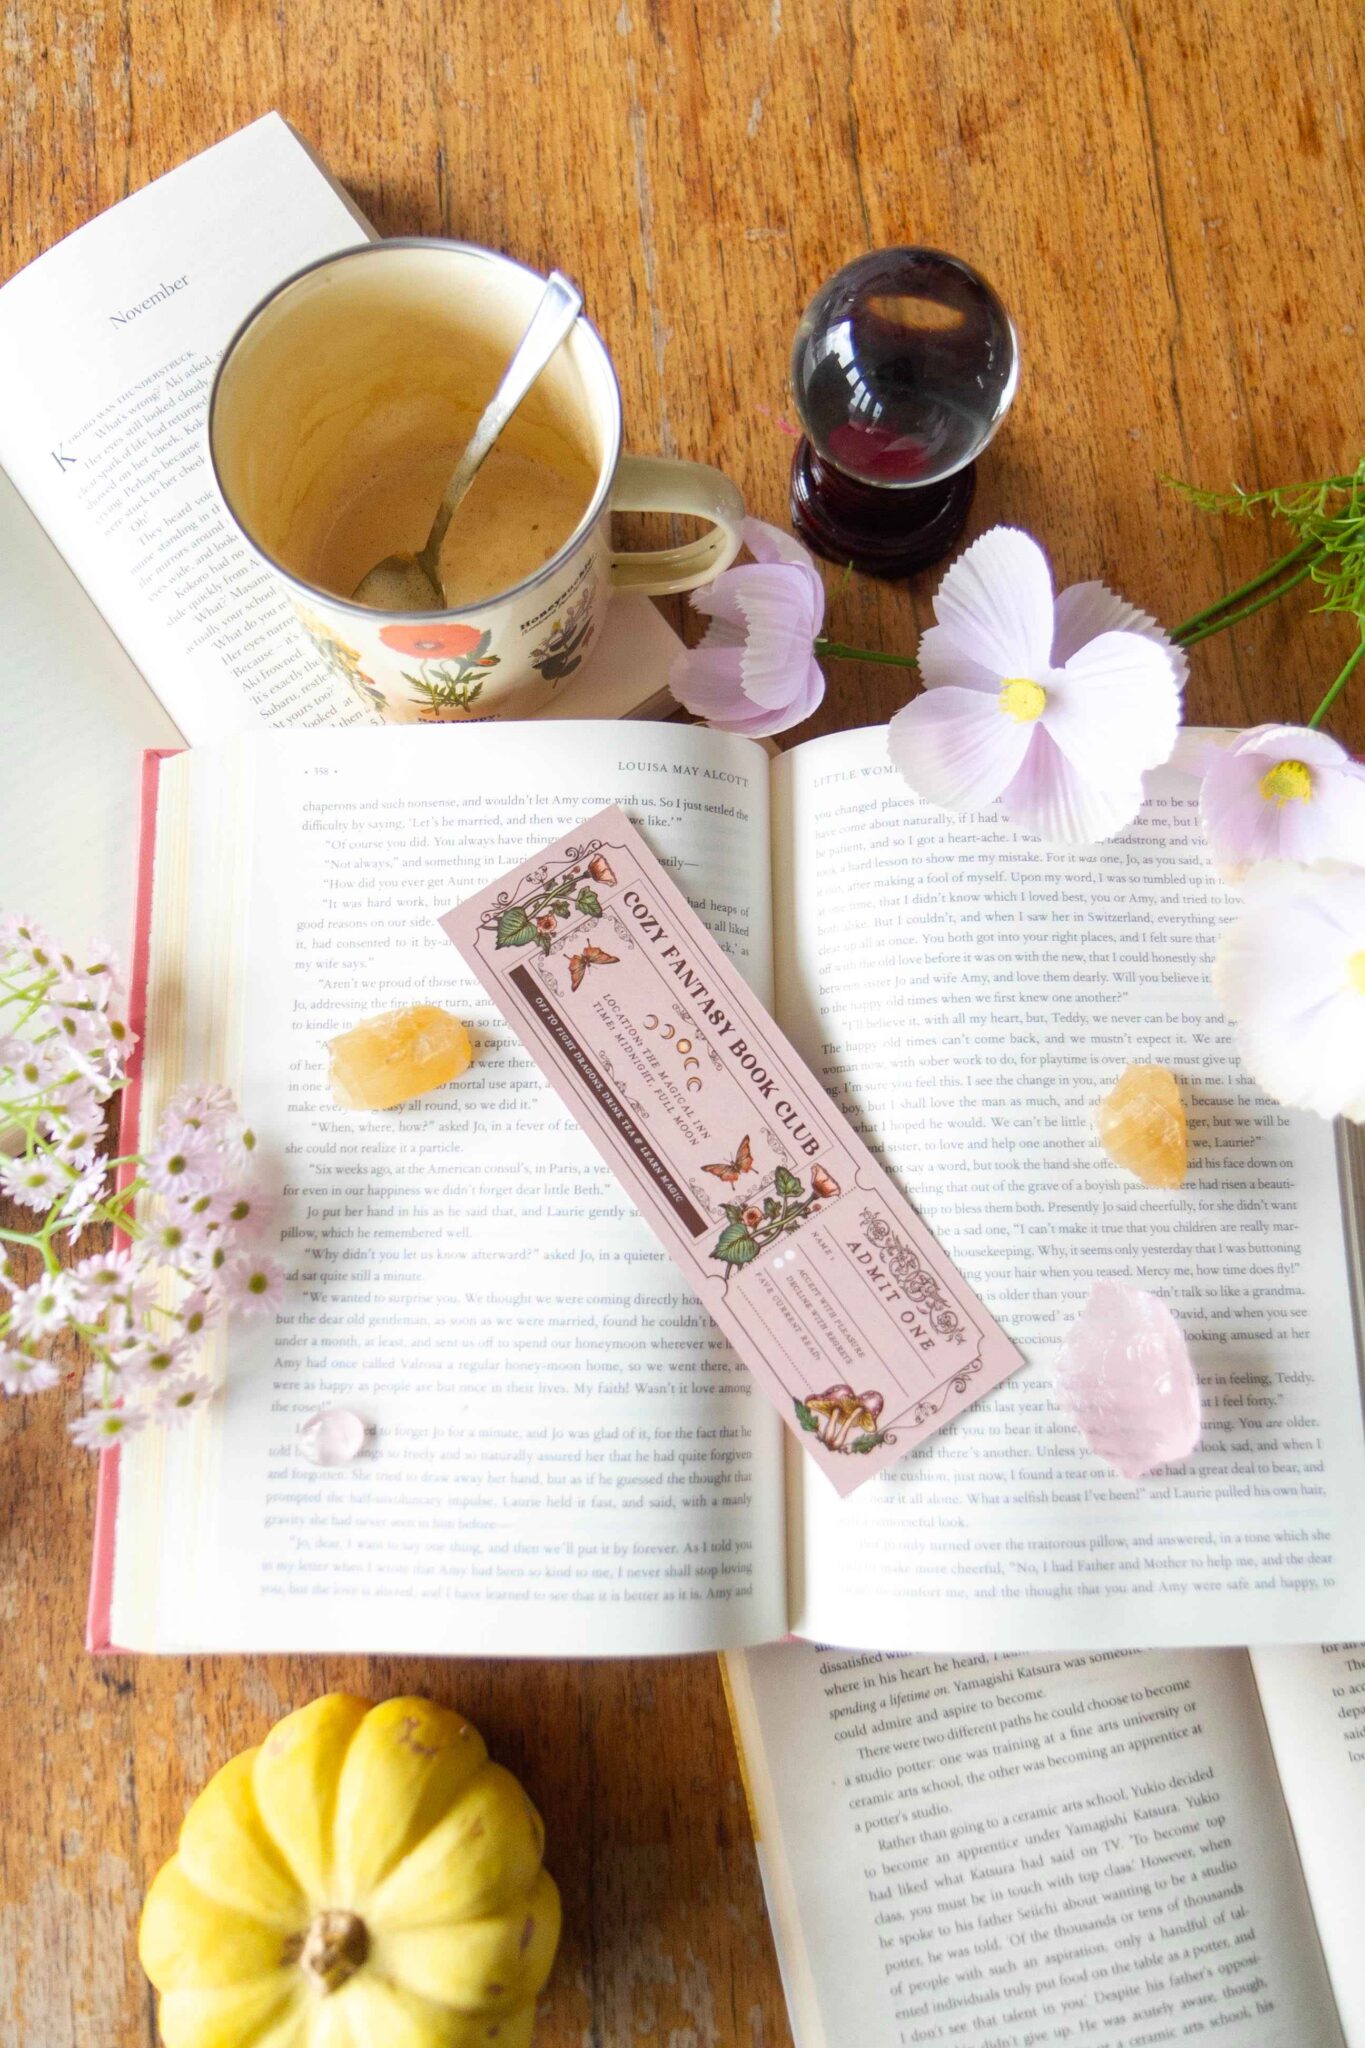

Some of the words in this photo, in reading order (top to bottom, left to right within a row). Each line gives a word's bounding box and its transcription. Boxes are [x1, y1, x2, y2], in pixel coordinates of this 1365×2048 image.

[108, 274, 188, 330] November
[166, 375, 183, 391] Aki
[138, 526, 162, 546] They
[162, 502, 193, 527] heard
[174, 572, 210, 599] Kokoro
[209, 556, 230, 574] had
[231, 549, 246, 562] no
[242, 674, 260, 692] Aki
[270, 670, 304, 696] exactly
[618, 761, 667, 772] LOUISA
[672, 764, 699, 775] MAY
[703, 769, 748, 787] ALCOTT
[814, 770, 856, 788] LITTLE
[301, 819, 348, 832] difficulty
[351, 818, 364, 831] by
[441, 815, 454, 826] be
[506, 813, 525, 824] and
[529, 813, 552, 824] then
[302, 800, 356, 814] chaperons
[359, 799, 378, 809] and
[380, 798, 404, 808] such
[461, 795, 481, 806] and
[535, 793, 548, 804] let
[552, 795, 579, 807] Amy
[582, 796, 610, 806] come
[615, 794, 640, 806] with
[659, 797, 673, 807] So
[676, 798, 680, 808] I
[682, 798, 701, 811] just
[703, 803, 734, 817] settled
[736, 808, 748, 821] the
[629, 817, 645, 827] we
[874, 917, 893, 927] But
[897, 914, 901, 926] I
[960, 911, 981, 922] and
[984, 910, 1015, 921] when
[1019, 911, 1023, 921] I
[1051, 911, 1070, 921] her
[1073, 912, 1084, 921] in
[1157, 912, 1216, 927] everything
[623, 891, 668, 942] COZY
[660, 944, 735, 1036] FANTASY
[728, 1038, 779, 1099] BOOK
[775, 1100, 819, 1155] CLUB
[535, 996, 549, 1011] OFF
[547, 1013, 557, 1025] TO
[555, 1027, 576, 1050] FIGHT
[573, 1051, 603, 1091] DRAGONS,
[601, 1091, 623, 1118] DRINK
[621, 1119, 635, 1136] TEA
[640, 1146, 662, 1173] LEARN
[660, 1175, 682, 1201] MAGIC
[614, 1032, 655, 1086] MIDNIGHT,
[653, 1088, 674, 1113] FULL
[673, 1115, 699, 1145] MOON
[642, 1047, 660, 1068] THE
[657, 1070, 694, 1117] MAGICAL
[692, 1119, 710, 1138] INN
[282, 1183, 300, 1197] for
[301, 1187, 328, 1195] even
[331, 1185, 341, 1195] in
[344, 1187, 365, 1196] our
[366, 1183, 420, 1199] happiness
[423, 1187, 439, 1195] we
[479, 1184, 512, 1197] forget
[515, 1183, 540, 1194] dear
[544, 1183, 569, 1195] little
[936, 1222, 951, 1236] be
[963, 1223, 983, 1235] sad
[1058, 1222, 1087, 1233] make
[1090, 1222, 1099, 1233] it
[1100, 1224, 1123, 1233] true
[1125, 1221, 1147, 1232] that
[1149, 1224, 1171, 1236] you
[1172, 1220, 1217, 1232] children
[1239, 1219, 1269, 1234] really
[754, 1271, 774, 1294] FAVE
[772, 1294, 802, 1332] CURRENT
[785, 1275, 812, 1309] DECLINE
[810, 1308, 828, 1330] WITH
[824, 1330, 853, 1364] REGRETS
[798, 1269, 821, 1296] ACCEPT
[819, 1296, 838, 1318] WITH
[833, 1318, 865, 1358] PLEASURE
[846, 1242, 900, 1301] ADMIT
[900, 1310, 935, 1350] ONE
[856, 1745, 890, 1759] There
[892, 1738, 920, 1751] were
[922, 1734, 945, 1745] two
[946, 1721, 998, 1740] different
[999, 1713, 1032, 1733] paths
[1033, 1710, 1048, 1722] he
[1050, 1700, 1085, 1718] could
[1086, 1695, 1128, 1710] choose
[1130, 1691, 1143, 1701] to
[1143, 1679, 1190, 1698] become
[877, 1835, 915, 1851] Rather
[919, 1829, 947, 1842] than
[949, 1822, 985, 1839] going
[986, 1818, 998, 1828] to
[1002, 1816, 1009, 1825] a
[1012, 1804, 1057, 1822] ceramic
[1062, 1800, 1083, 1812] arts
[1130, 1780, 1166, 1797] Yukio
[1168, 1765, 1214, 1788] decided
